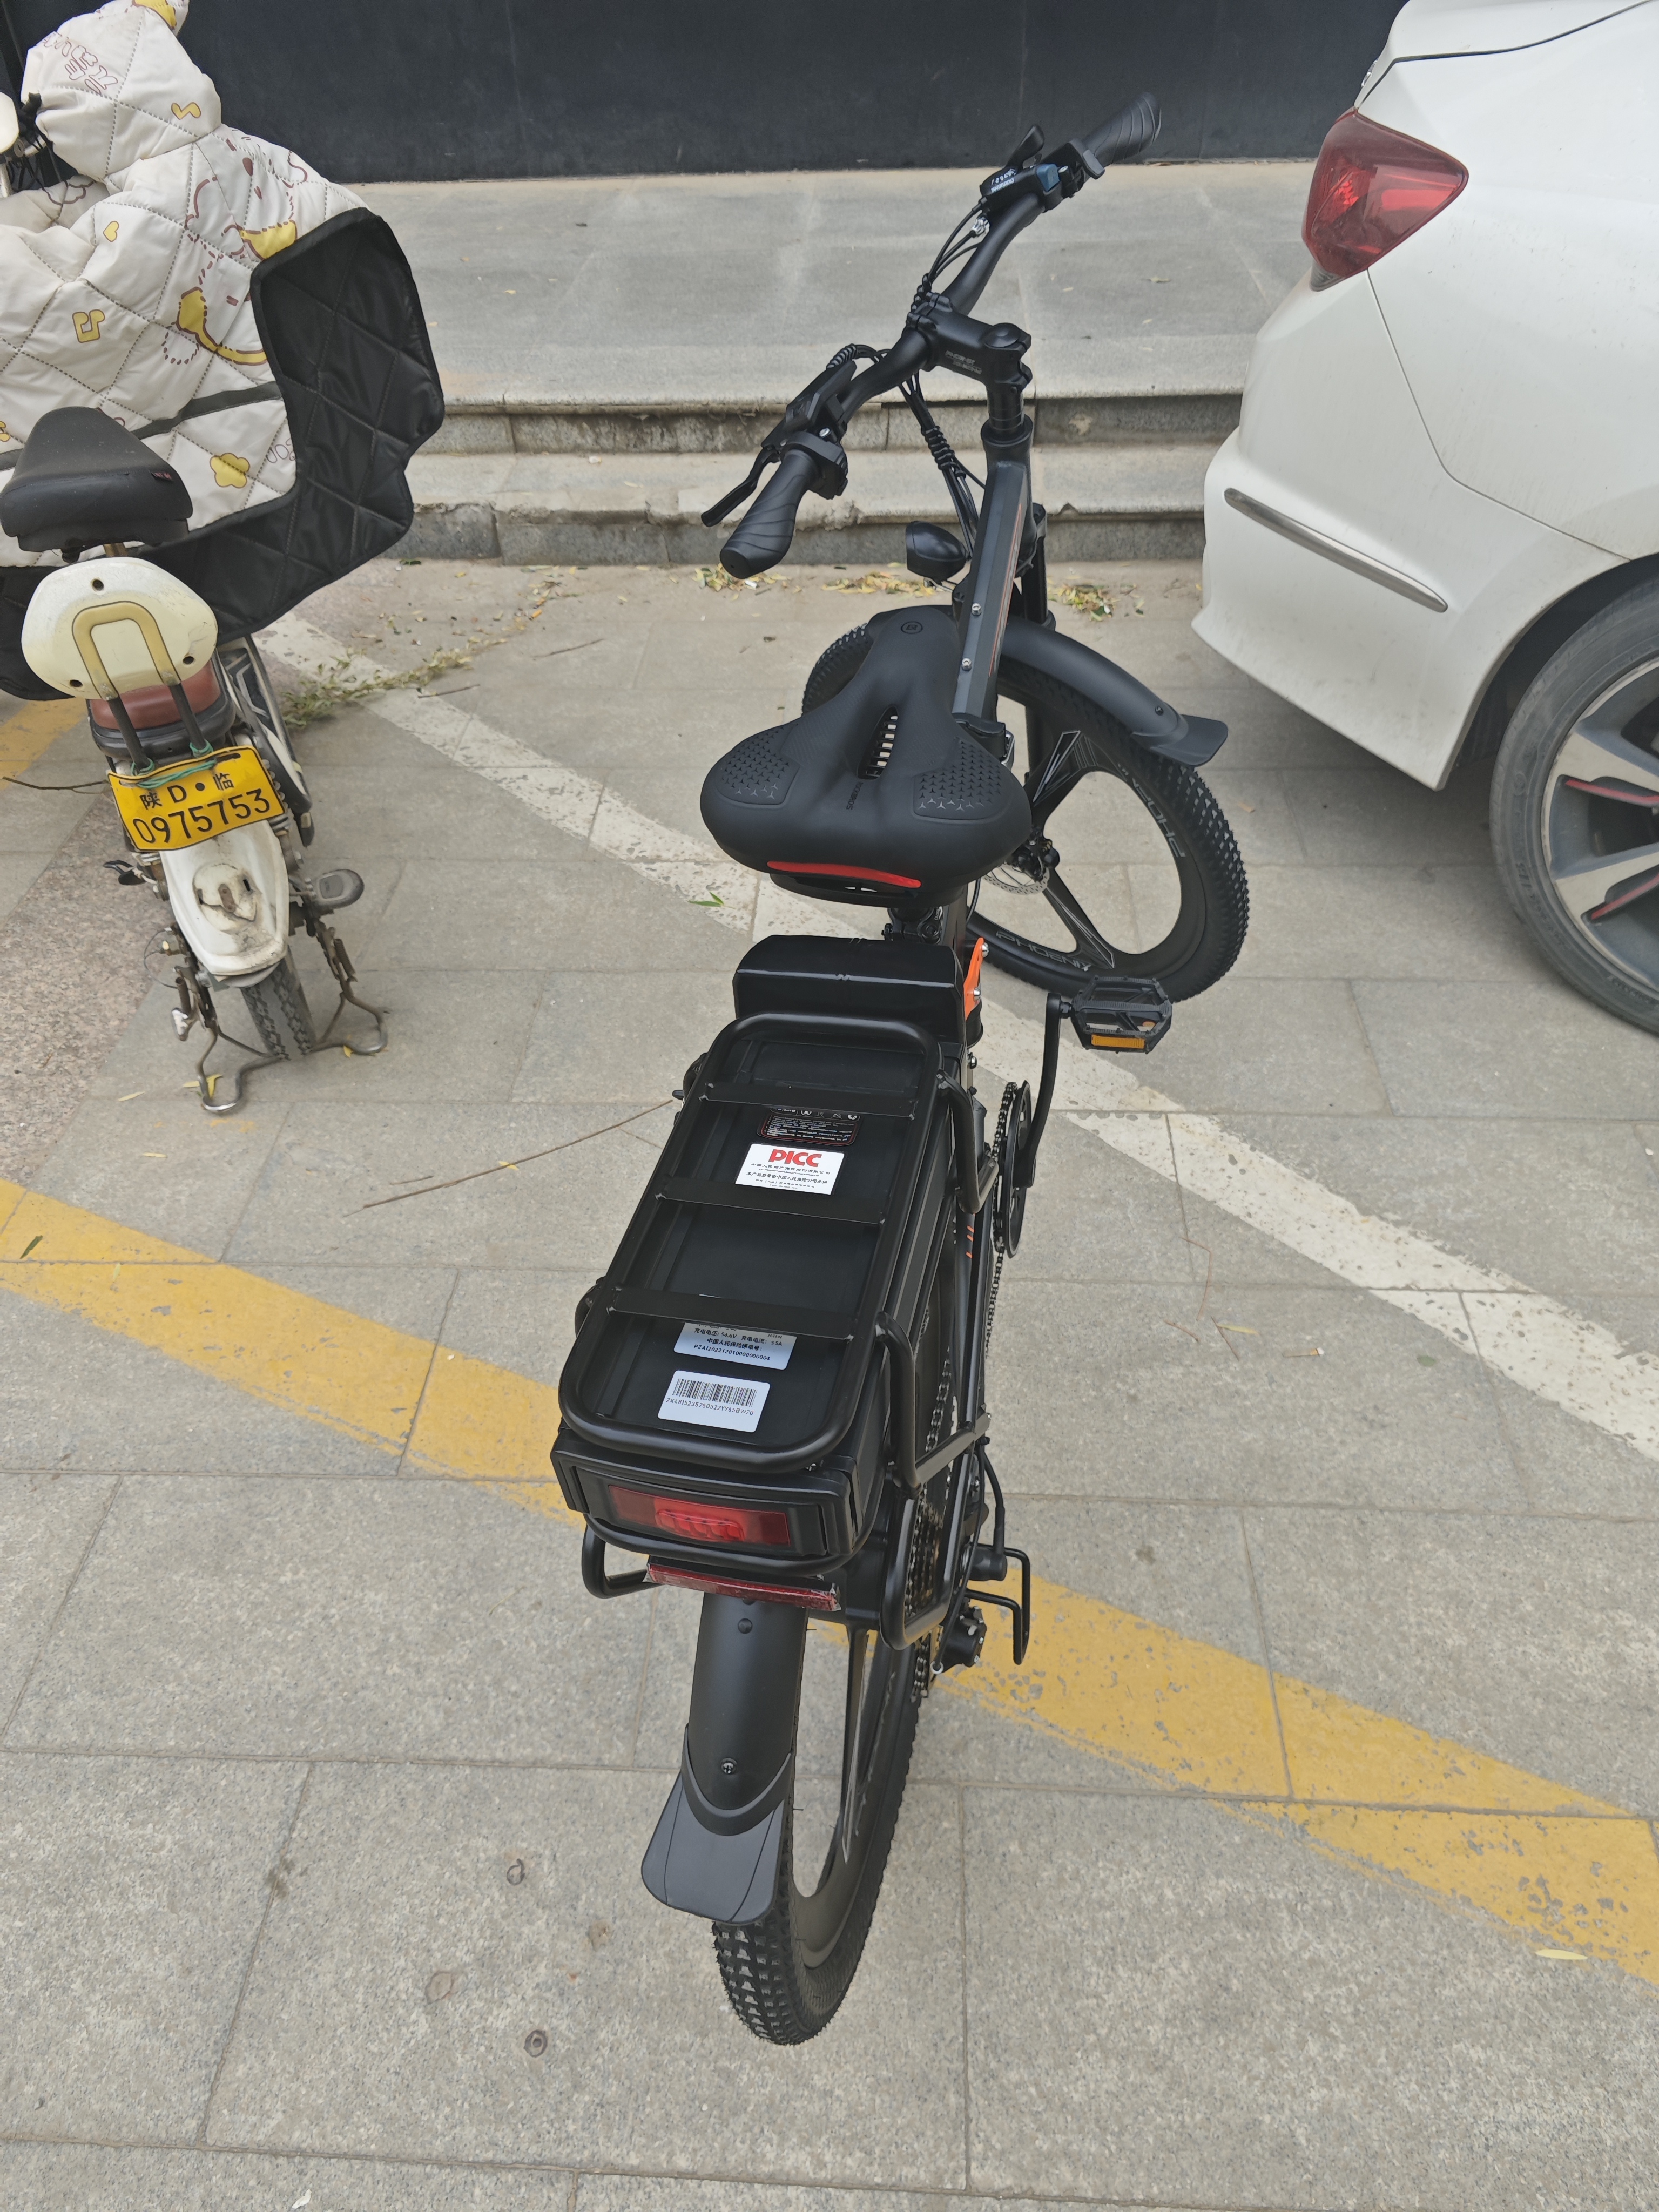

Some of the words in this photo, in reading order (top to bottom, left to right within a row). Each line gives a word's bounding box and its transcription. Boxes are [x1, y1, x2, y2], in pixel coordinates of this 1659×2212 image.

[132, 788, 271, 844] 0975753
[996, 930, 1092, 972] PHOENIX
[768, 1149, 822, 1168] PICC
